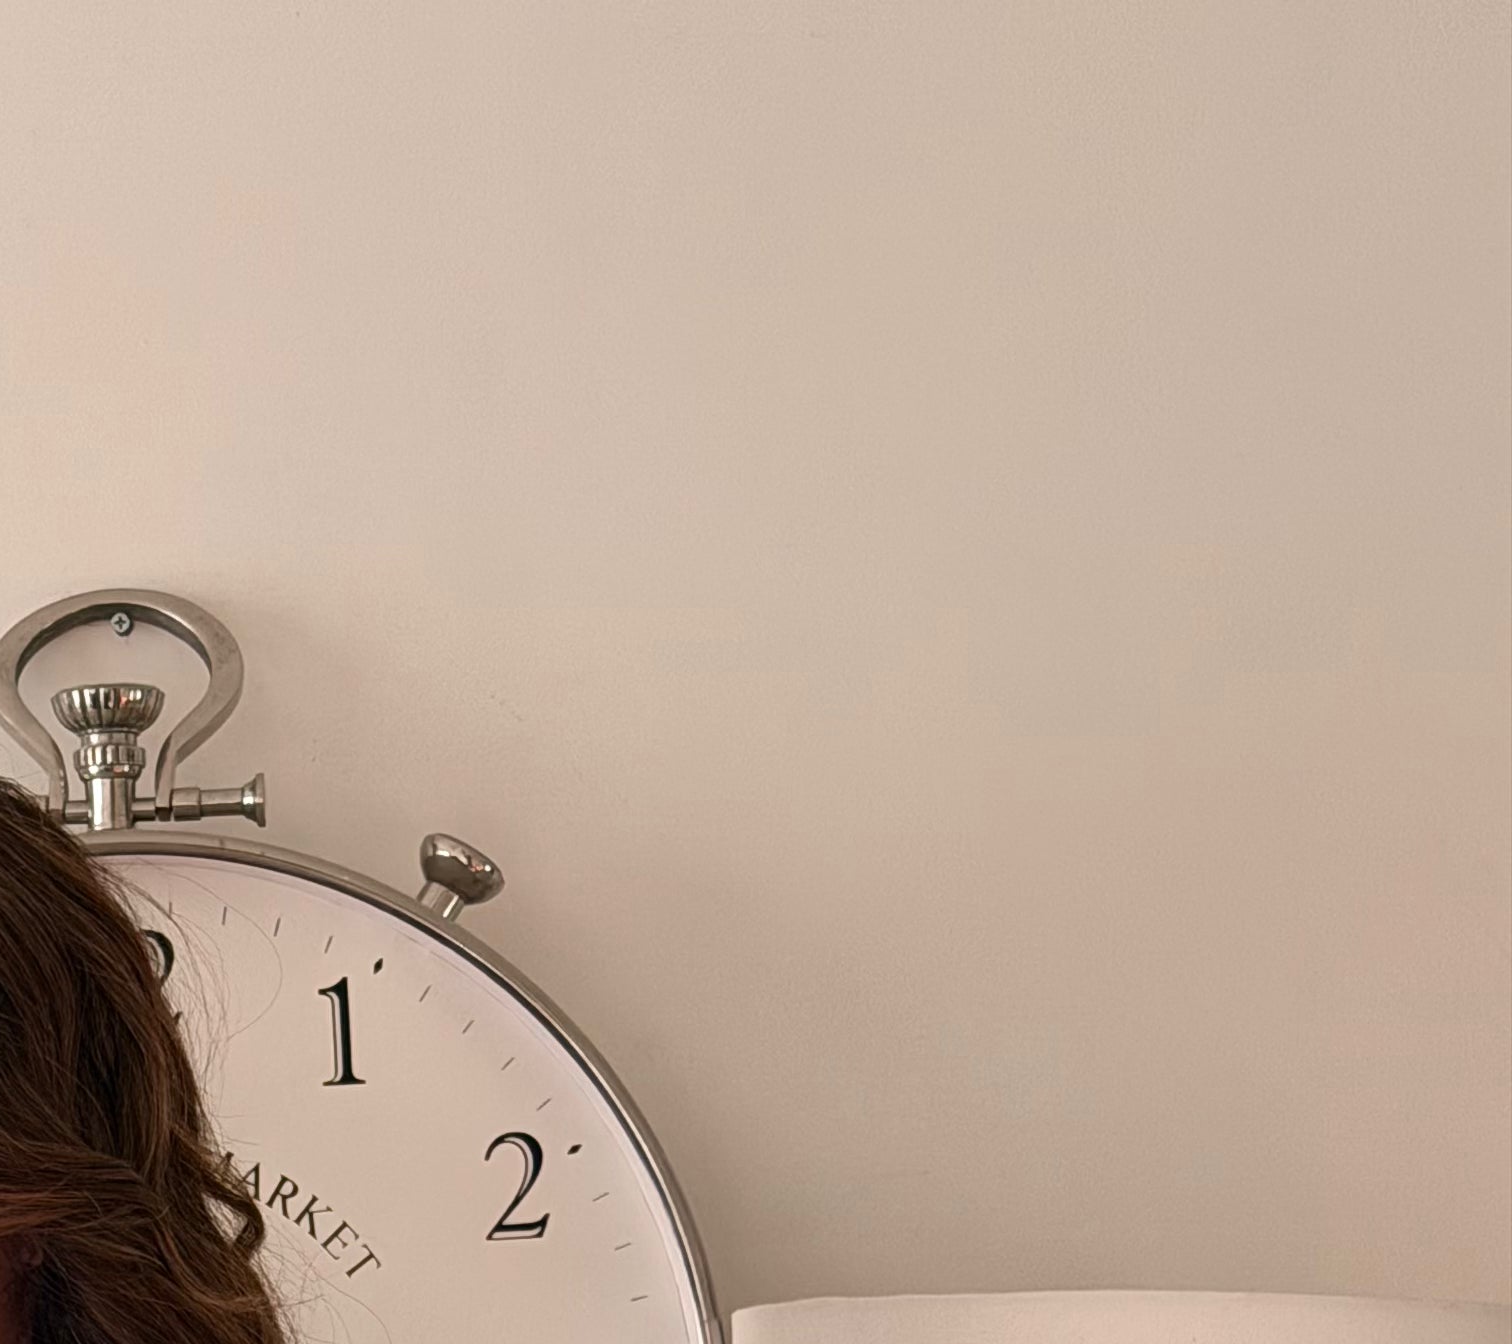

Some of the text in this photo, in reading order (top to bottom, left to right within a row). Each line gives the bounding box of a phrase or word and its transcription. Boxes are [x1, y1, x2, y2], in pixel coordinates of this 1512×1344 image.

[317, 976, 366, 1086] 1
[221, 1151, 381, 1278] ARKET
[485, 1131, 550, 1241] 2
